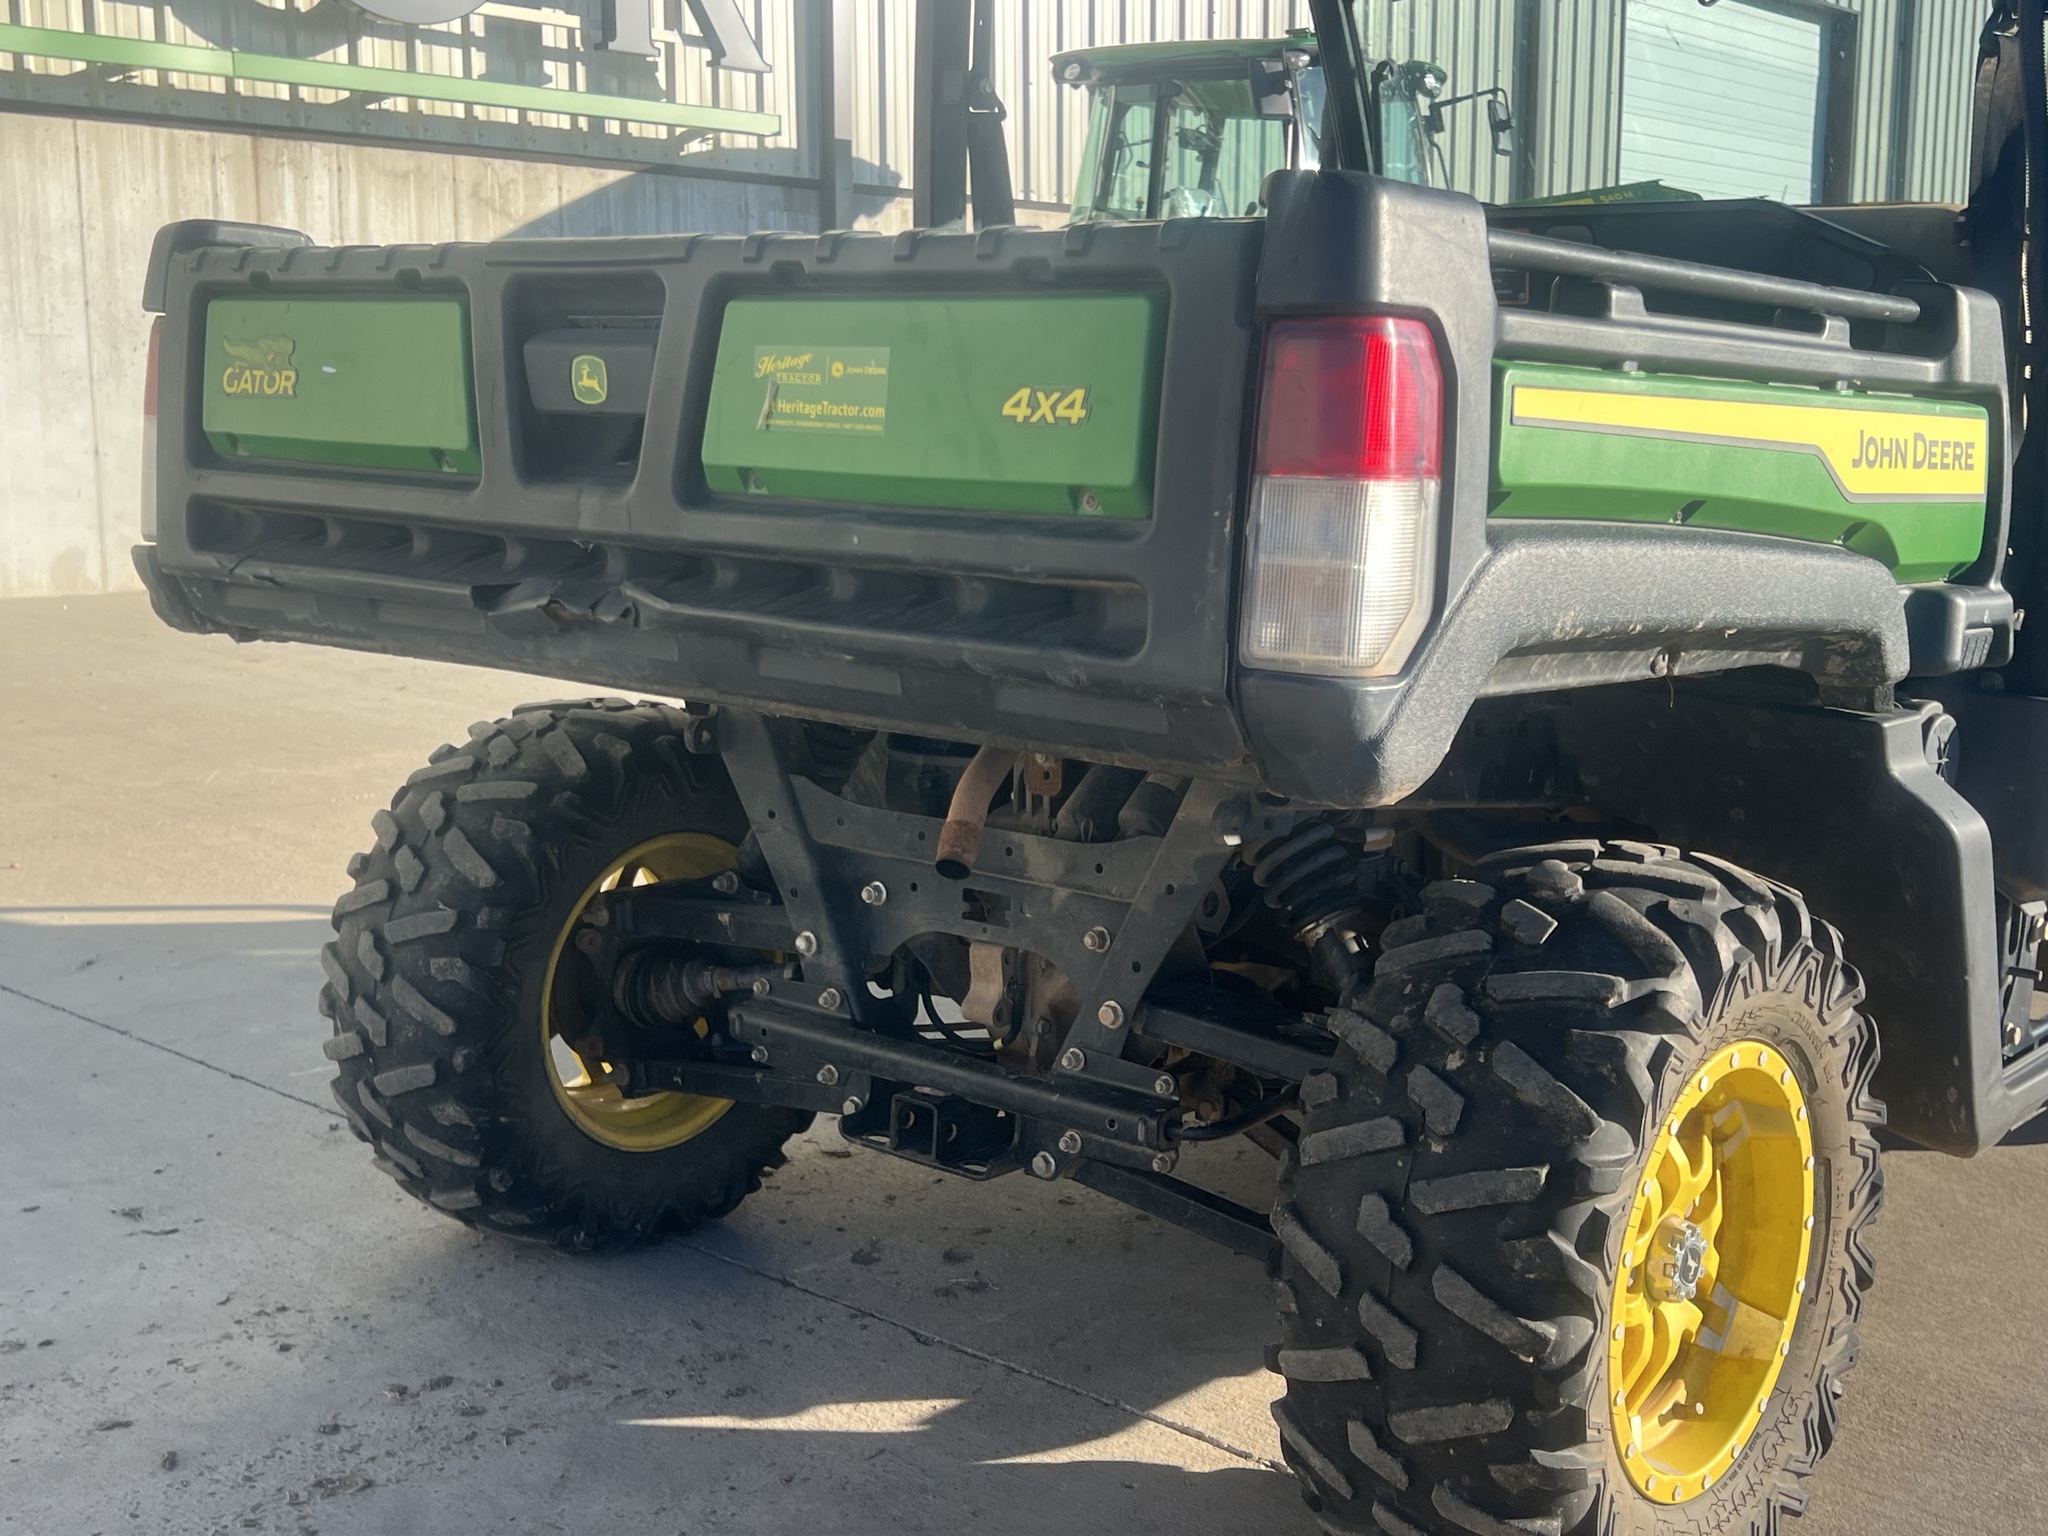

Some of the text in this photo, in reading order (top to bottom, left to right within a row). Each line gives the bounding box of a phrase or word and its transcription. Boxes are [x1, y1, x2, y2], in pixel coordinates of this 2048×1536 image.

[755, 353, 813, 378] Heritage
[223, 367, 296, 395] GATOR
[776, 373, 822, 384] TRACTOR
[777, 399, 886, 419] HeritageTractor.com
[1852, 429, 1975, 471] JOHN DEERE
